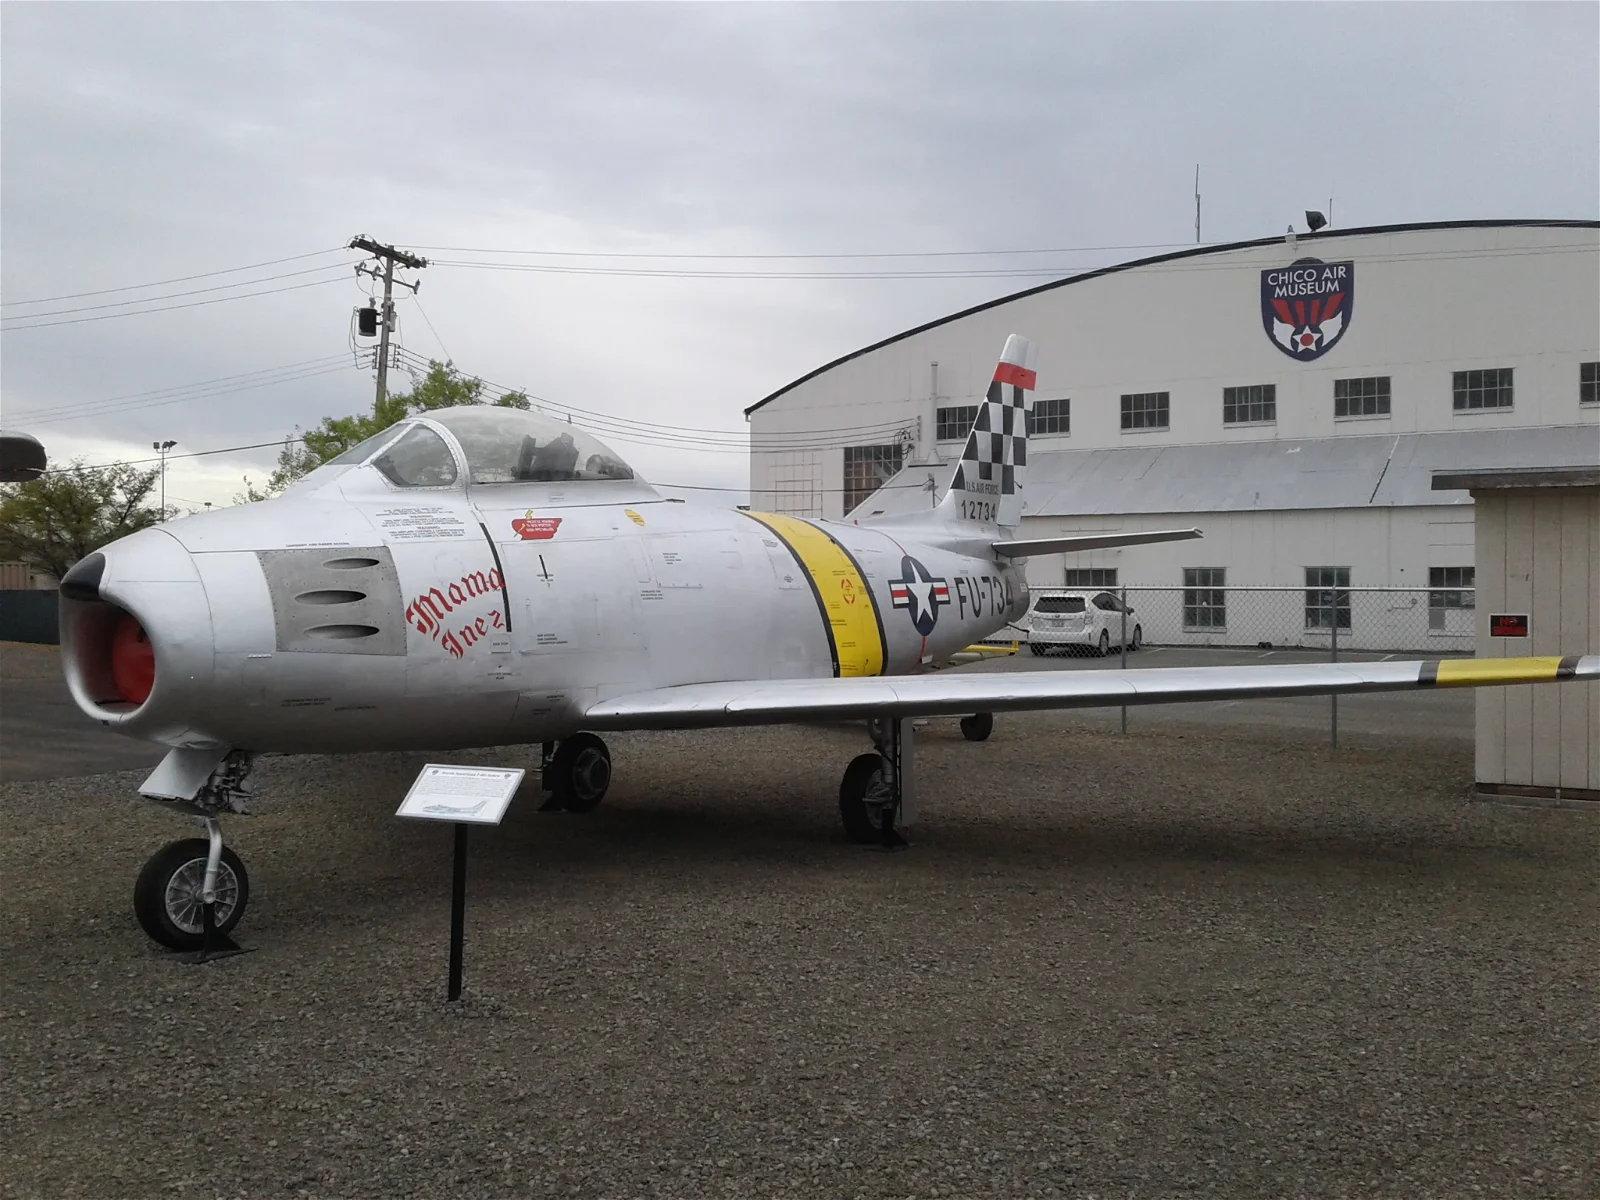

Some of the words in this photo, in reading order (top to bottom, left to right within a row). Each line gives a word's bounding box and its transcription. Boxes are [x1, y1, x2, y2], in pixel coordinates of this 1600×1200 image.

[1267, 269, 1317, 286] CHICO
[1321, 266, 1347, 280] AIR
[1274, 279, 1340, 298] MUSEUM
[975, 482, 985, 494] AIR
[985, 483, 999, 496] FORCE
[961, 499, 996, 521] 12734
[405, 567, 505, 642] Mama
[954, 576, 1014, 620] FU-734
[441, 610, 505, 660] Inez
